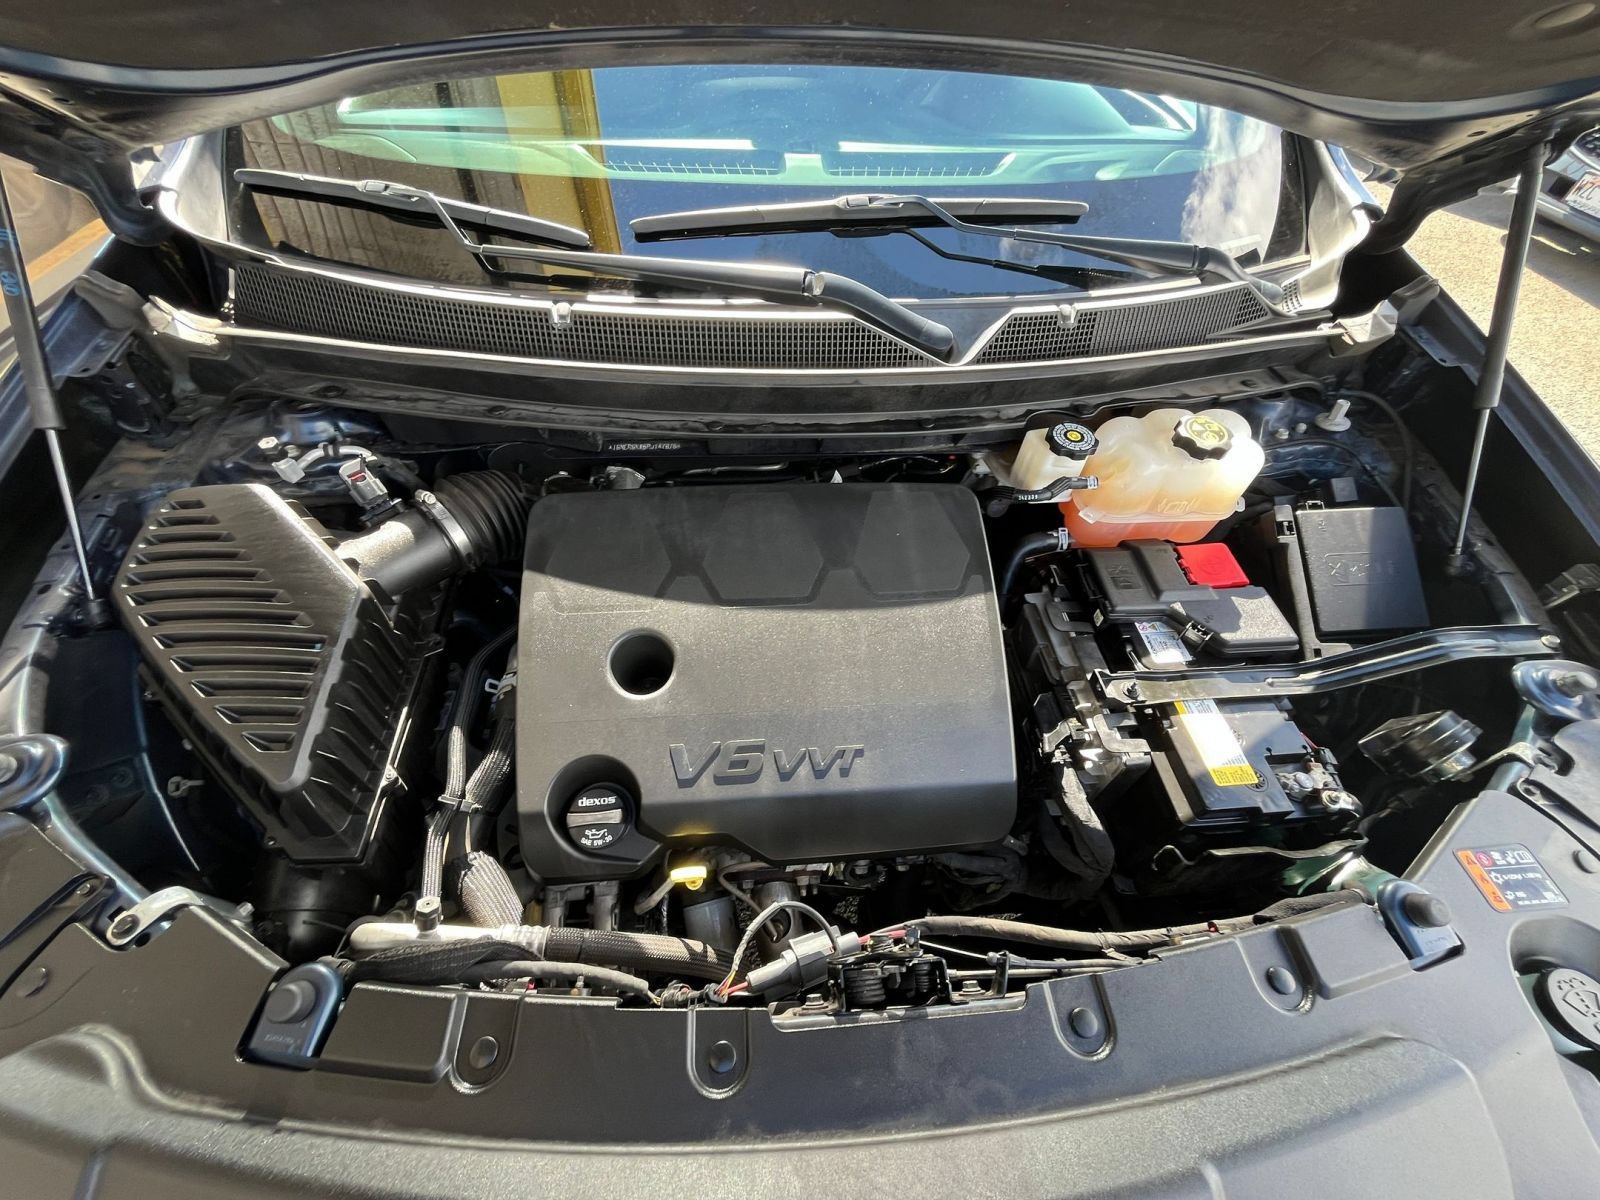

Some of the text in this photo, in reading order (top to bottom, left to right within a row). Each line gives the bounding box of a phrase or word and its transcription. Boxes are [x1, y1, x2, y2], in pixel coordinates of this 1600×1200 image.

[669, 739, 864, 787] V6 VVT
[578, 796, 617, 807] dexos
[581, 834, 613, 846] SAE 5W-30
